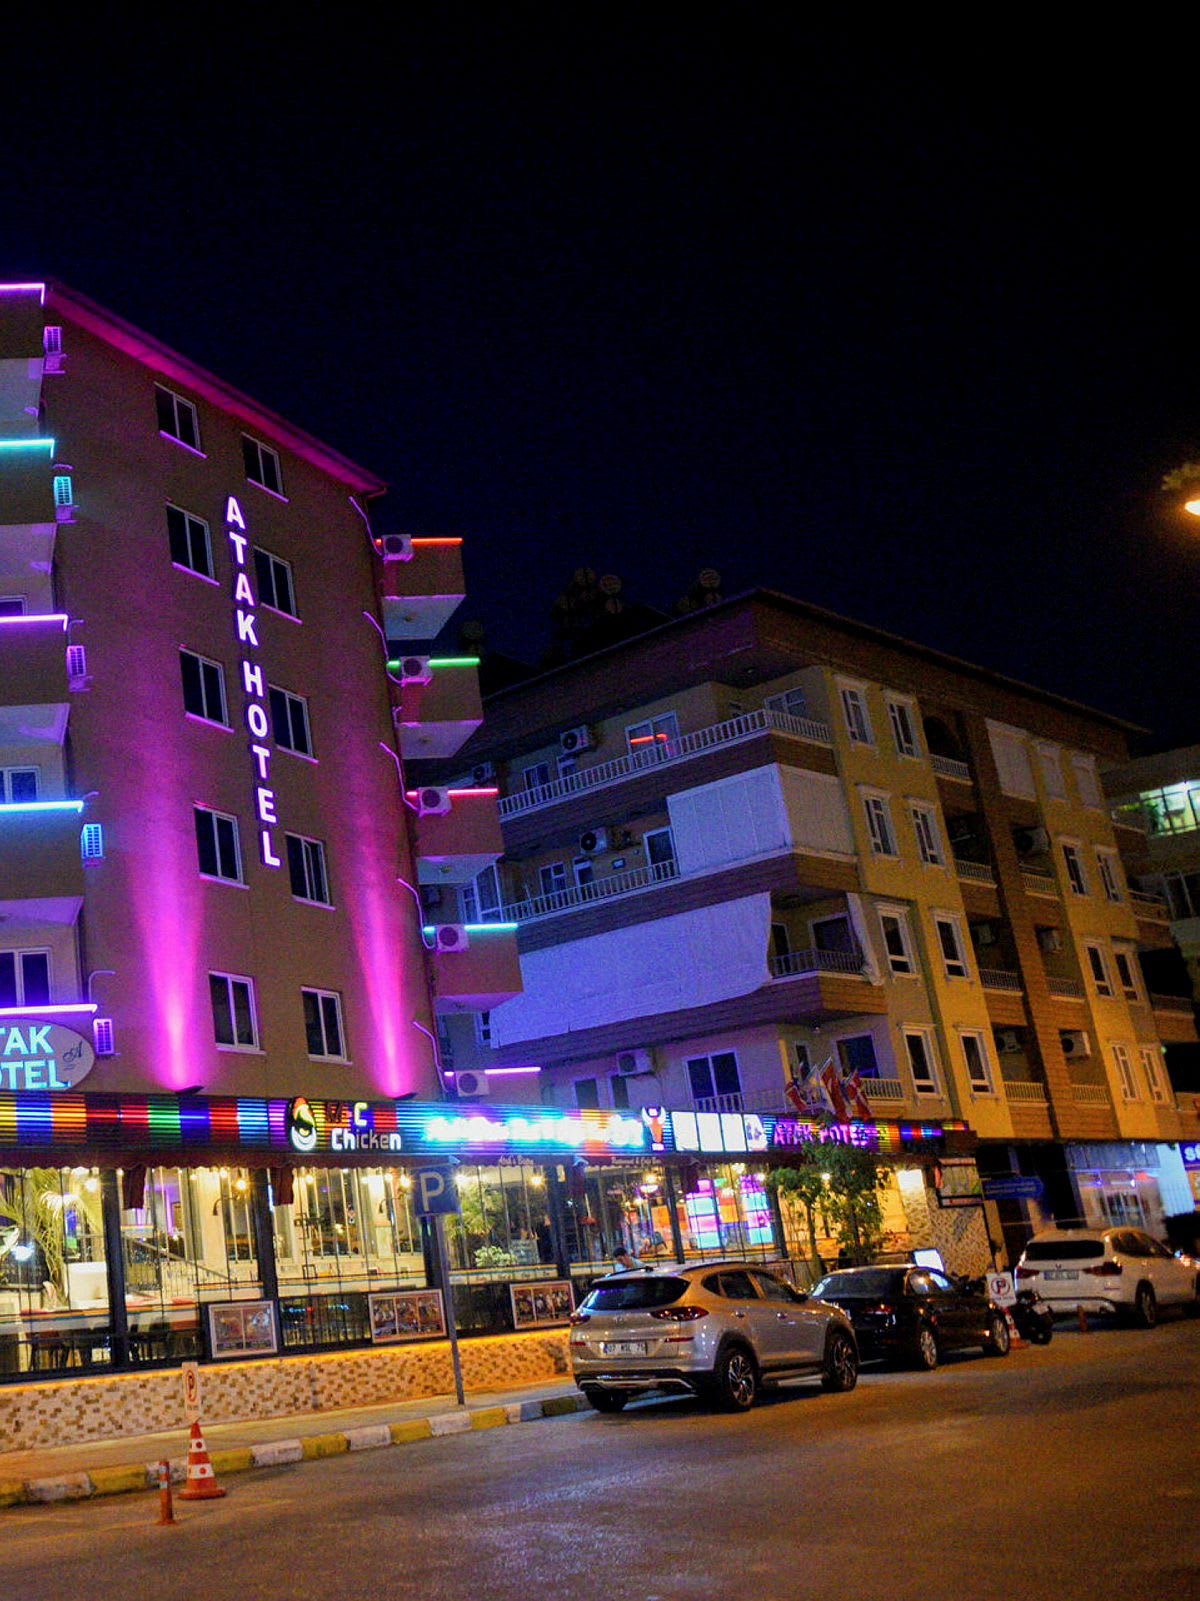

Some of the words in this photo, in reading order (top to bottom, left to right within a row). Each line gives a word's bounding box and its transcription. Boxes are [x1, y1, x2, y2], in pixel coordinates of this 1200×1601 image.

[225, 495, 260, 647] ATAK
[242, 660, 282, 868] HOTEL
[331, 1127, 402, 1151] Chicken
[419, 1171, 445, 1212] P
